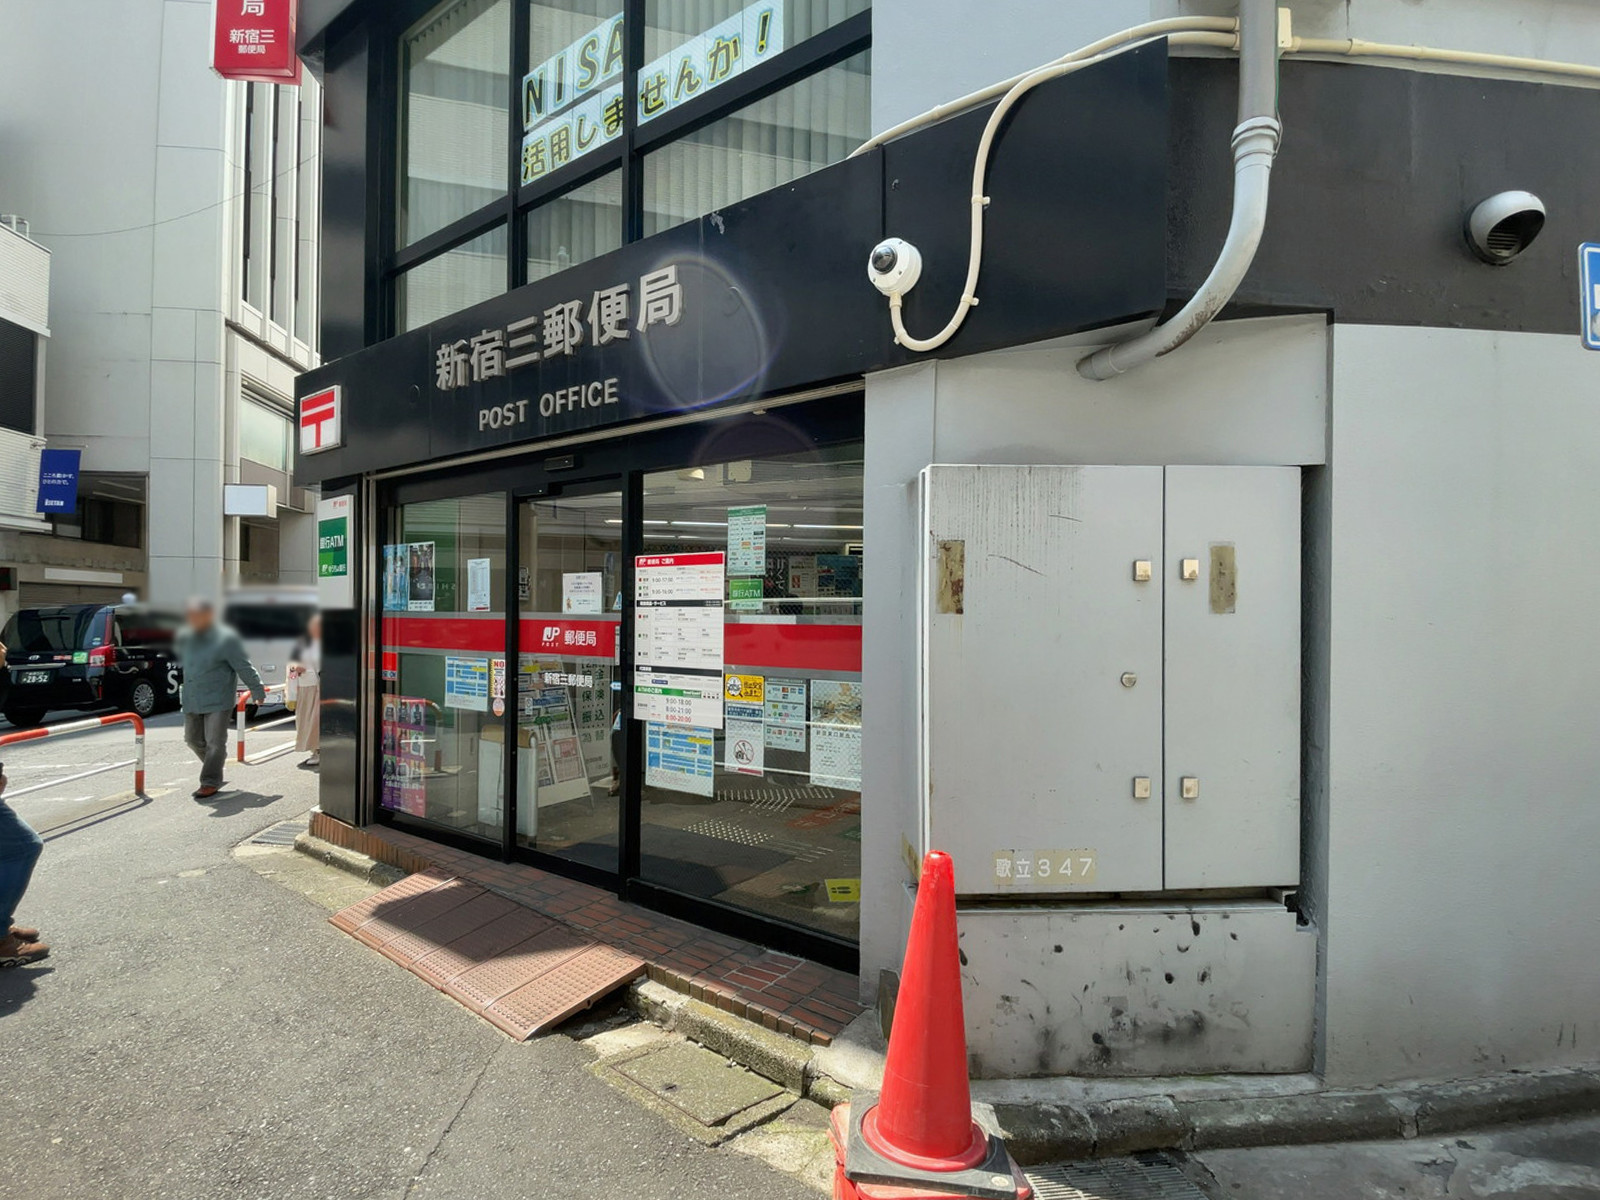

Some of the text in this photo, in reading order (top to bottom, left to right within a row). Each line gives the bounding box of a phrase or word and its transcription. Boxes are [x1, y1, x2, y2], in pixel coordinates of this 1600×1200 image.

[229, 28, 275, 43] 新宿三
[237, 44, 266, 54] 郵便局
[524, 18, 623, 128] NISA
[435, 264, 684, 391] 新宿三郵便局
[479, 378, 619, 431] POST OFFICE
[320, 535, 344, 549] 銀行ATM
[732, 589, 761, 598] 銀行ATM
[564, 630, 597, 647] 郵便局
[543, 672, 593, 688] 新宿三郵便局
[996, 857, 1093, 878] 歌立347
